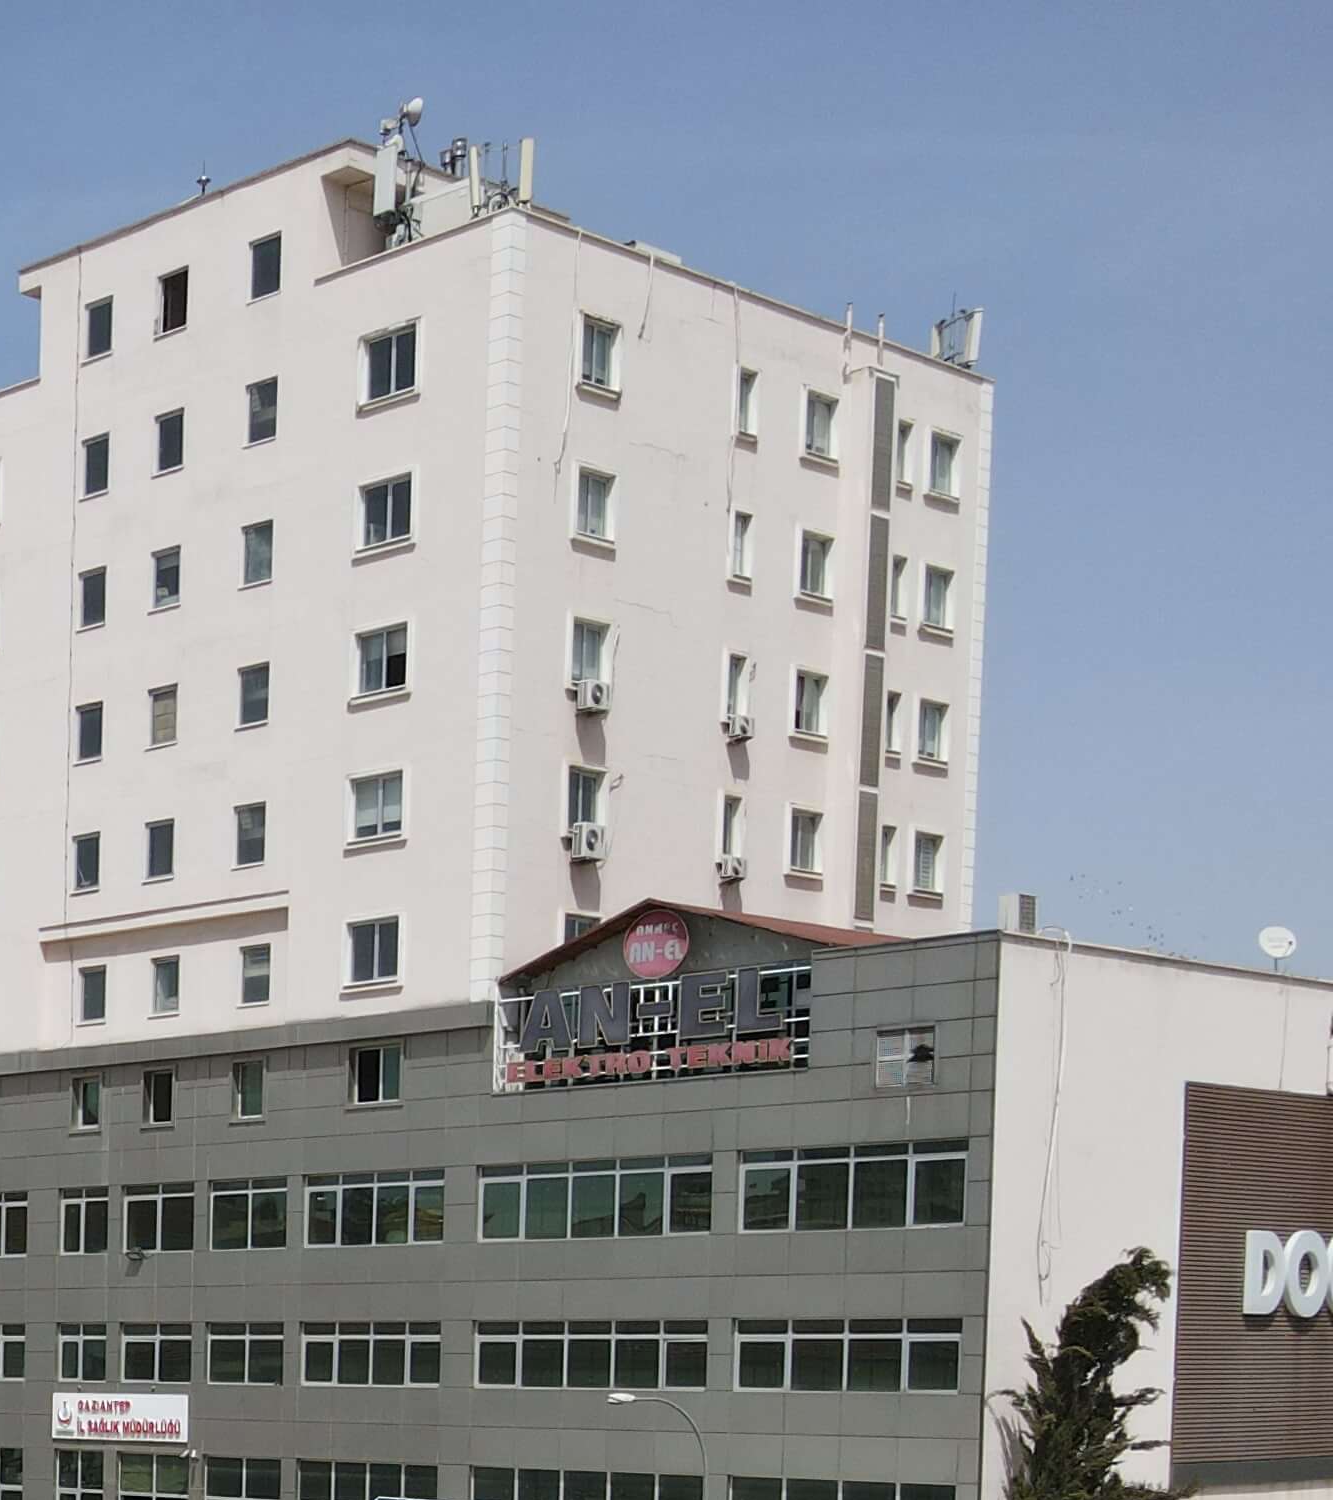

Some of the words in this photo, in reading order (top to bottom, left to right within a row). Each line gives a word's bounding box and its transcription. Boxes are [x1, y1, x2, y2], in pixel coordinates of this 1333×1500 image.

[519, 966, 784, 1053] AN-EL
[506, 1050, 653, 1083] ELEKTRO
[1242, 1229, 1333, 1319] DO
